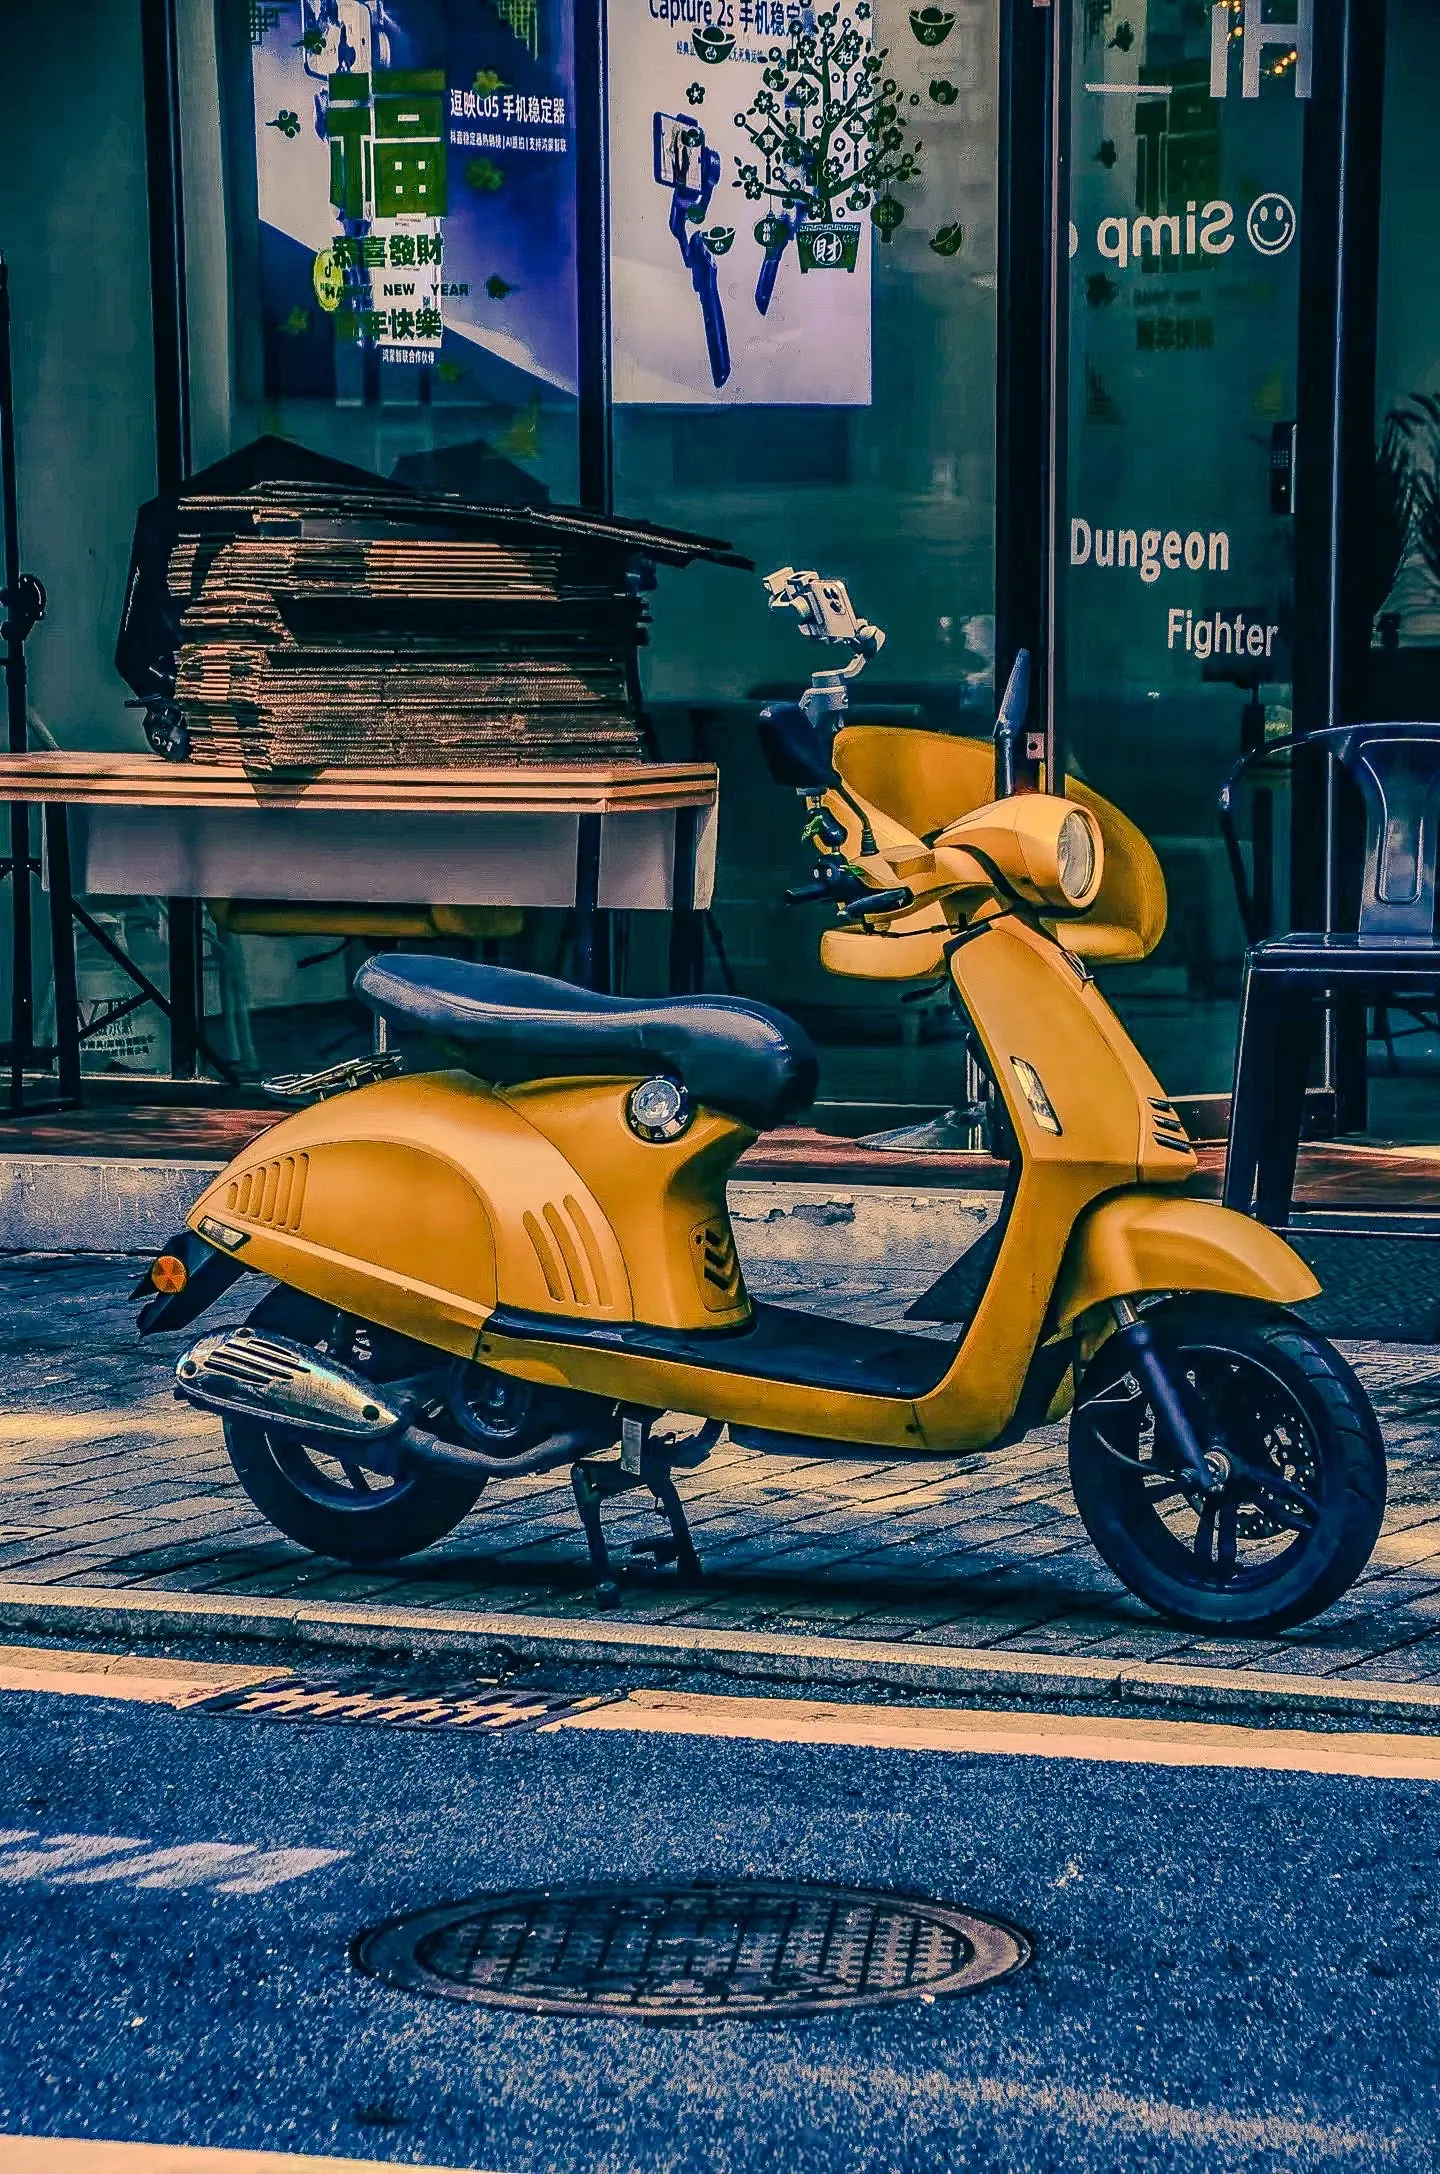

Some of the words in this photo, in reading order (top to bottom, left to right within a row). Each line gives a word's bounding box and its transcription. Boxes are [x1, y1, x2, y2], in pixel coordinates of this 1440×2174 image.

[650, 0, 712, 27] Capture
[717, 0, 734, 27] 2s
[503, 94, 565, 124] 手机稳定器
[383, 284, 416, 296] NEW
[430, 284, 470, 296] YEAR
[1070, 518, 1230, 583] Dungeon
[1167, 608, 1279, 659] Fighter
